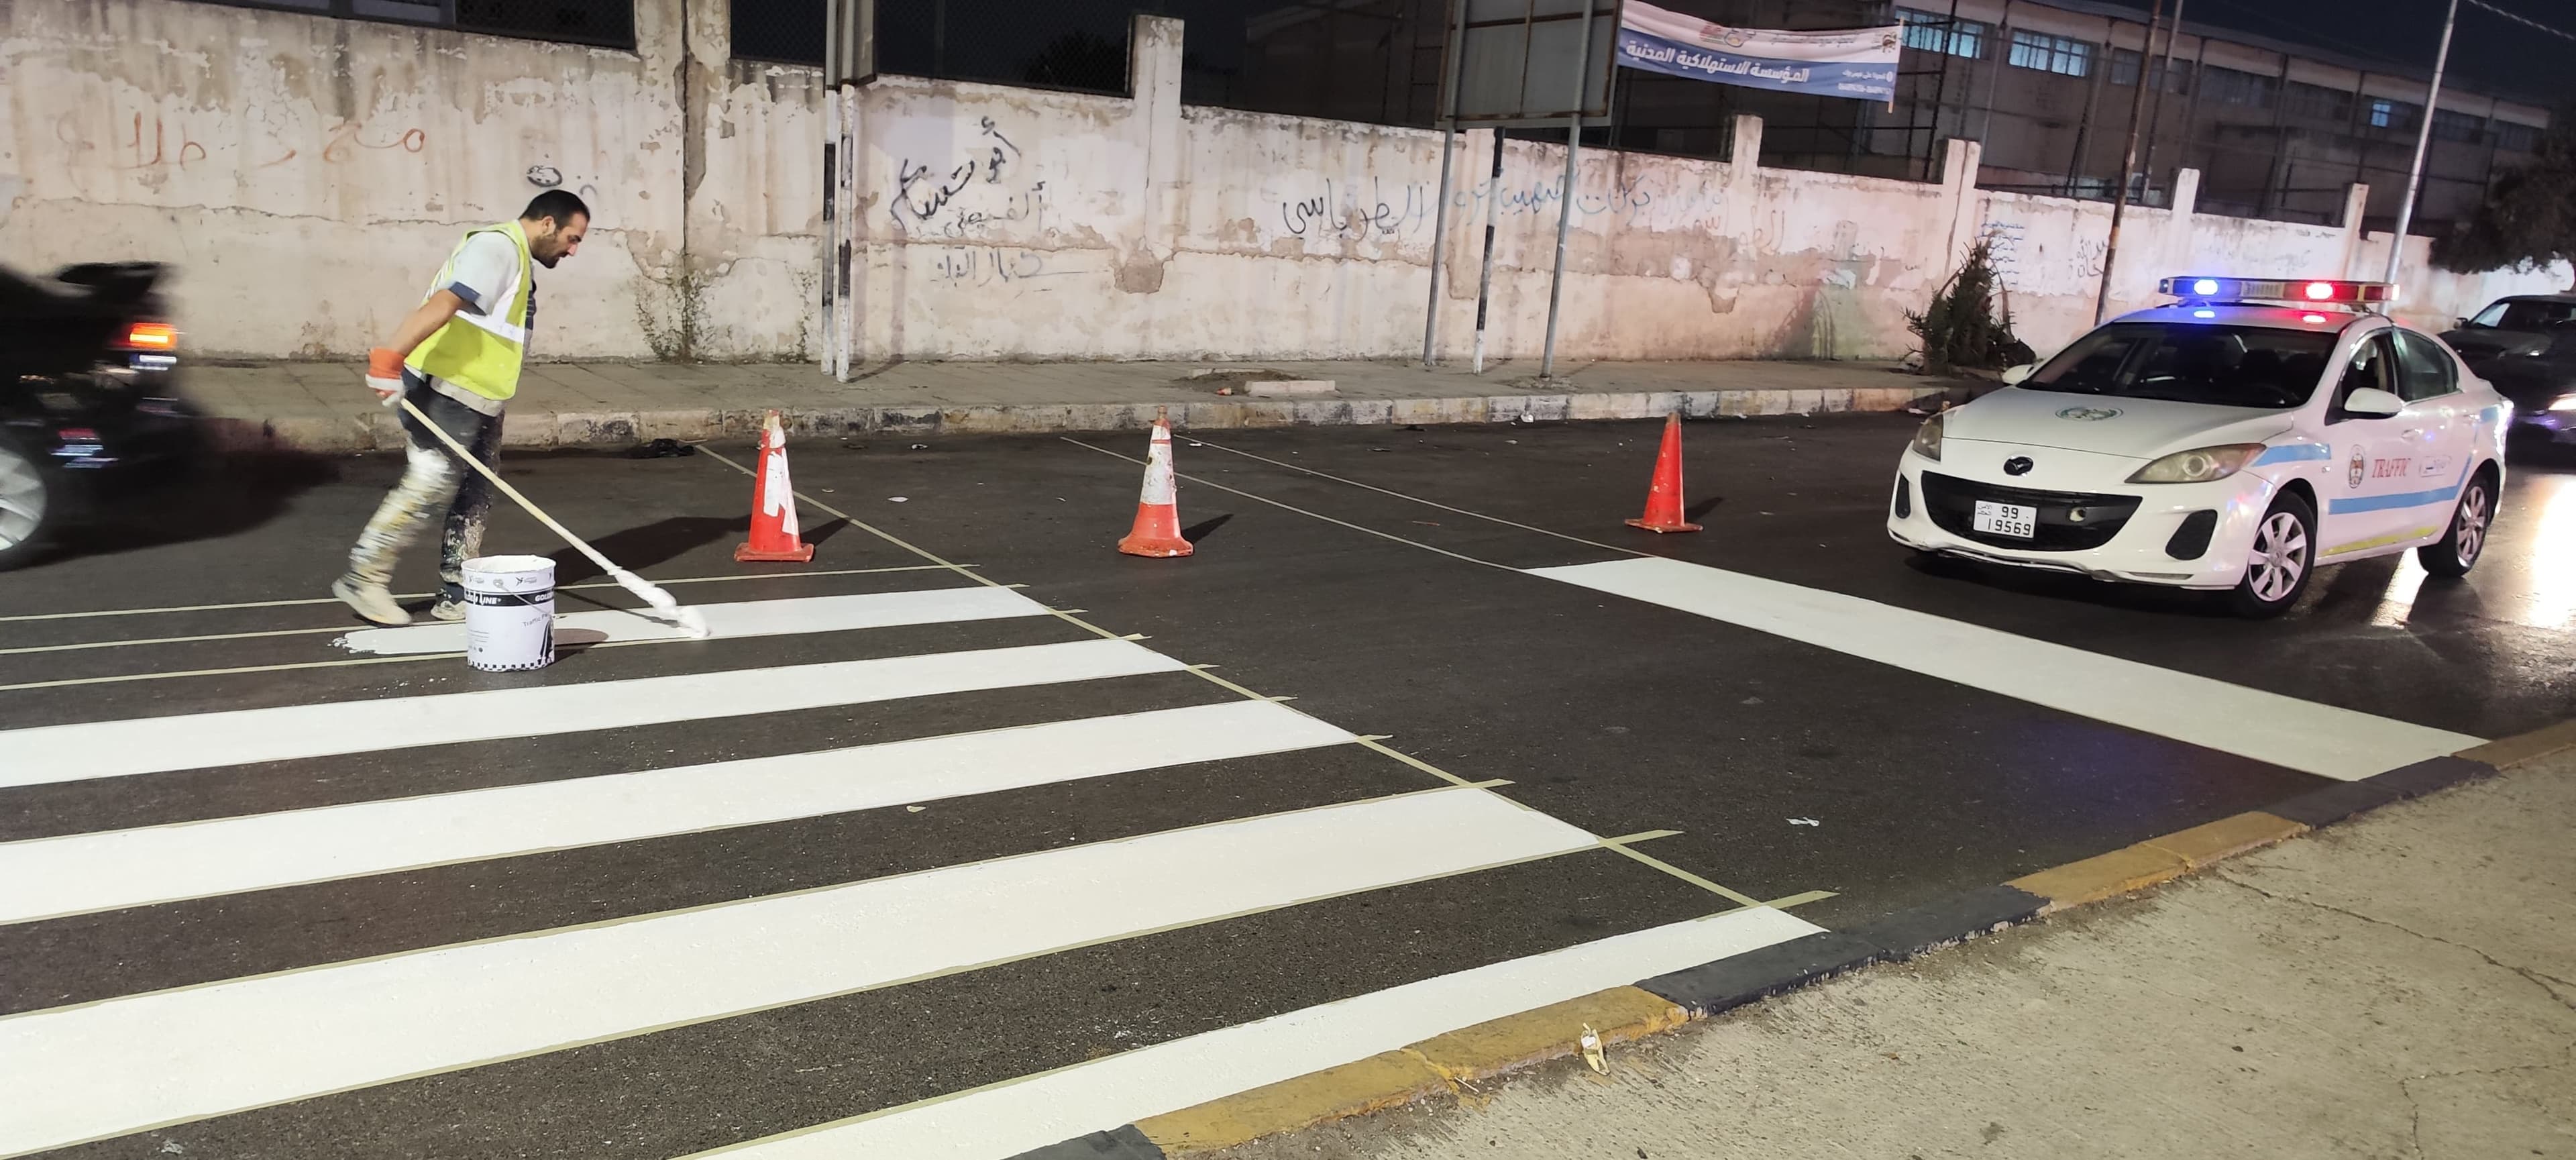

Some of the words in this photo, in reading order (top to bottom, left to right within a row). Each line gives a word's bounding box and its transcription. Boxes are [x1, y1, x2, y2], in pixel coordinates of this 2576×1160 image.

[1625, 40, 1676, 63] المدنية
[1676, 49, 1750, 75] الاستهلاكية
[1750, 62, 1809, 84] المؤسسة
[2371, 458, 2412, 478] TRAFFIC
[2001, 506, 2019, 519] 99
[1988, 518, 2031, 535] 19569
